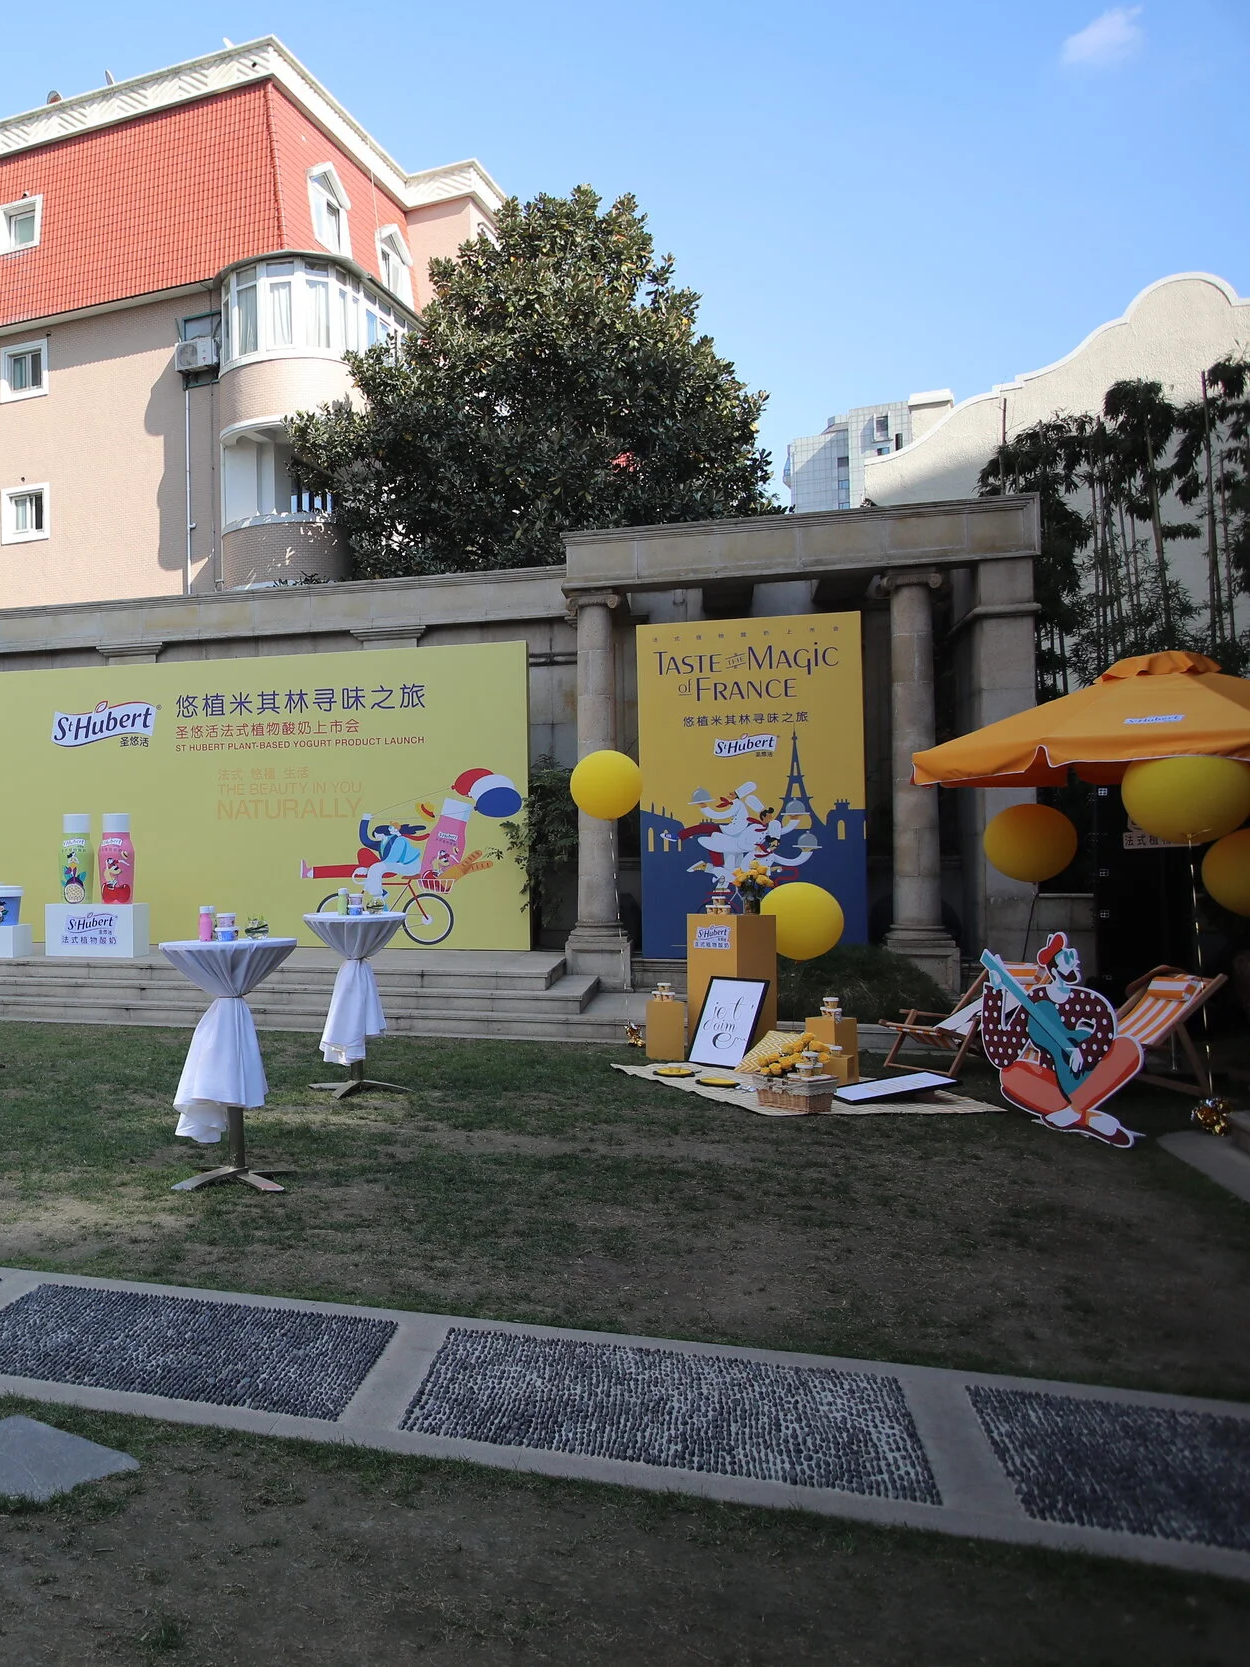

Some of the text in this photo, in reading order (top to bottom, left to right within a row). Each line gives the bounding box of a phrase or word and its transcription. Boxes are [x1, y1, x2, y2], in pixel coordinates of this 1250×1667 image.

[678, 677, 798, 702] of FRANCE
[175, 683, 426, 718] 悠植米其林寻味之旅
[683, 711, 808, 727] 悠植米其林寻味之旅
[175, 718, 360, 739] 圣悠活法式植物酸奶上市会
[119, 736, 149, 747] 圣悠活
[175, 736, 425, 752] ST HUBERT PLANT-BASED YOGURT PRODUCT LAUNCH
[218, 781, 362, 796] THE BEAUTY IN YOU
[217, 797, 362, 820] NATURALLY
